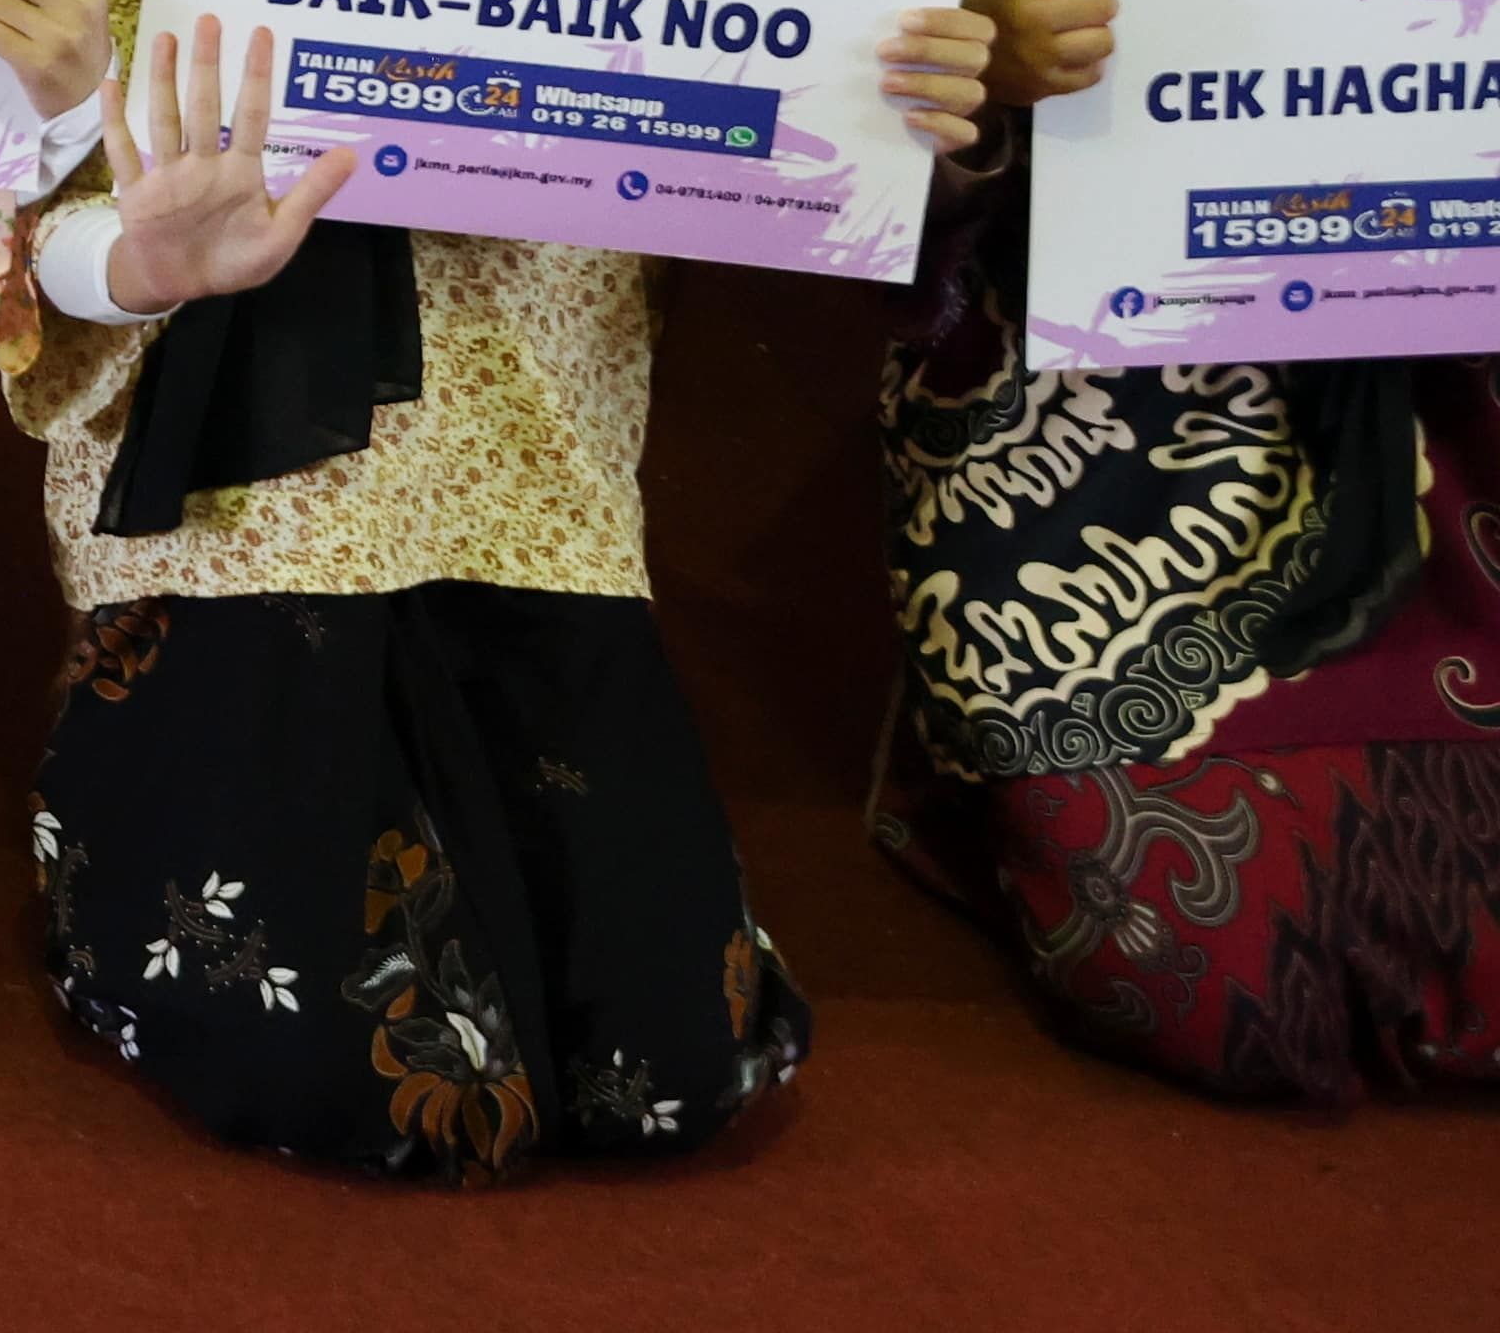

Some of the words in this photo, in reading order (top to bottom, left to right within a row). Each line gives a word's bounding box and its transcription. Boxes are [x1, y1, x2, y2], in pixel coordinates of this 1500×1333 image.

[296, 51, 376, 75] TALIAN
[292, 70, 456, 115] 15999
[481, 85, 522, 110] 24
[534, 84, 666, 120] Whatsapp
[1147, 69, 1265, 123] CEK
[531, 107, 577, 127] 019
[591, 114, 627, 133] 26
[635, 118, 723, 143] 15999
[1193, 199, 1270, 218] TALIAN
[1193, 215, 1352, 249] 15999
